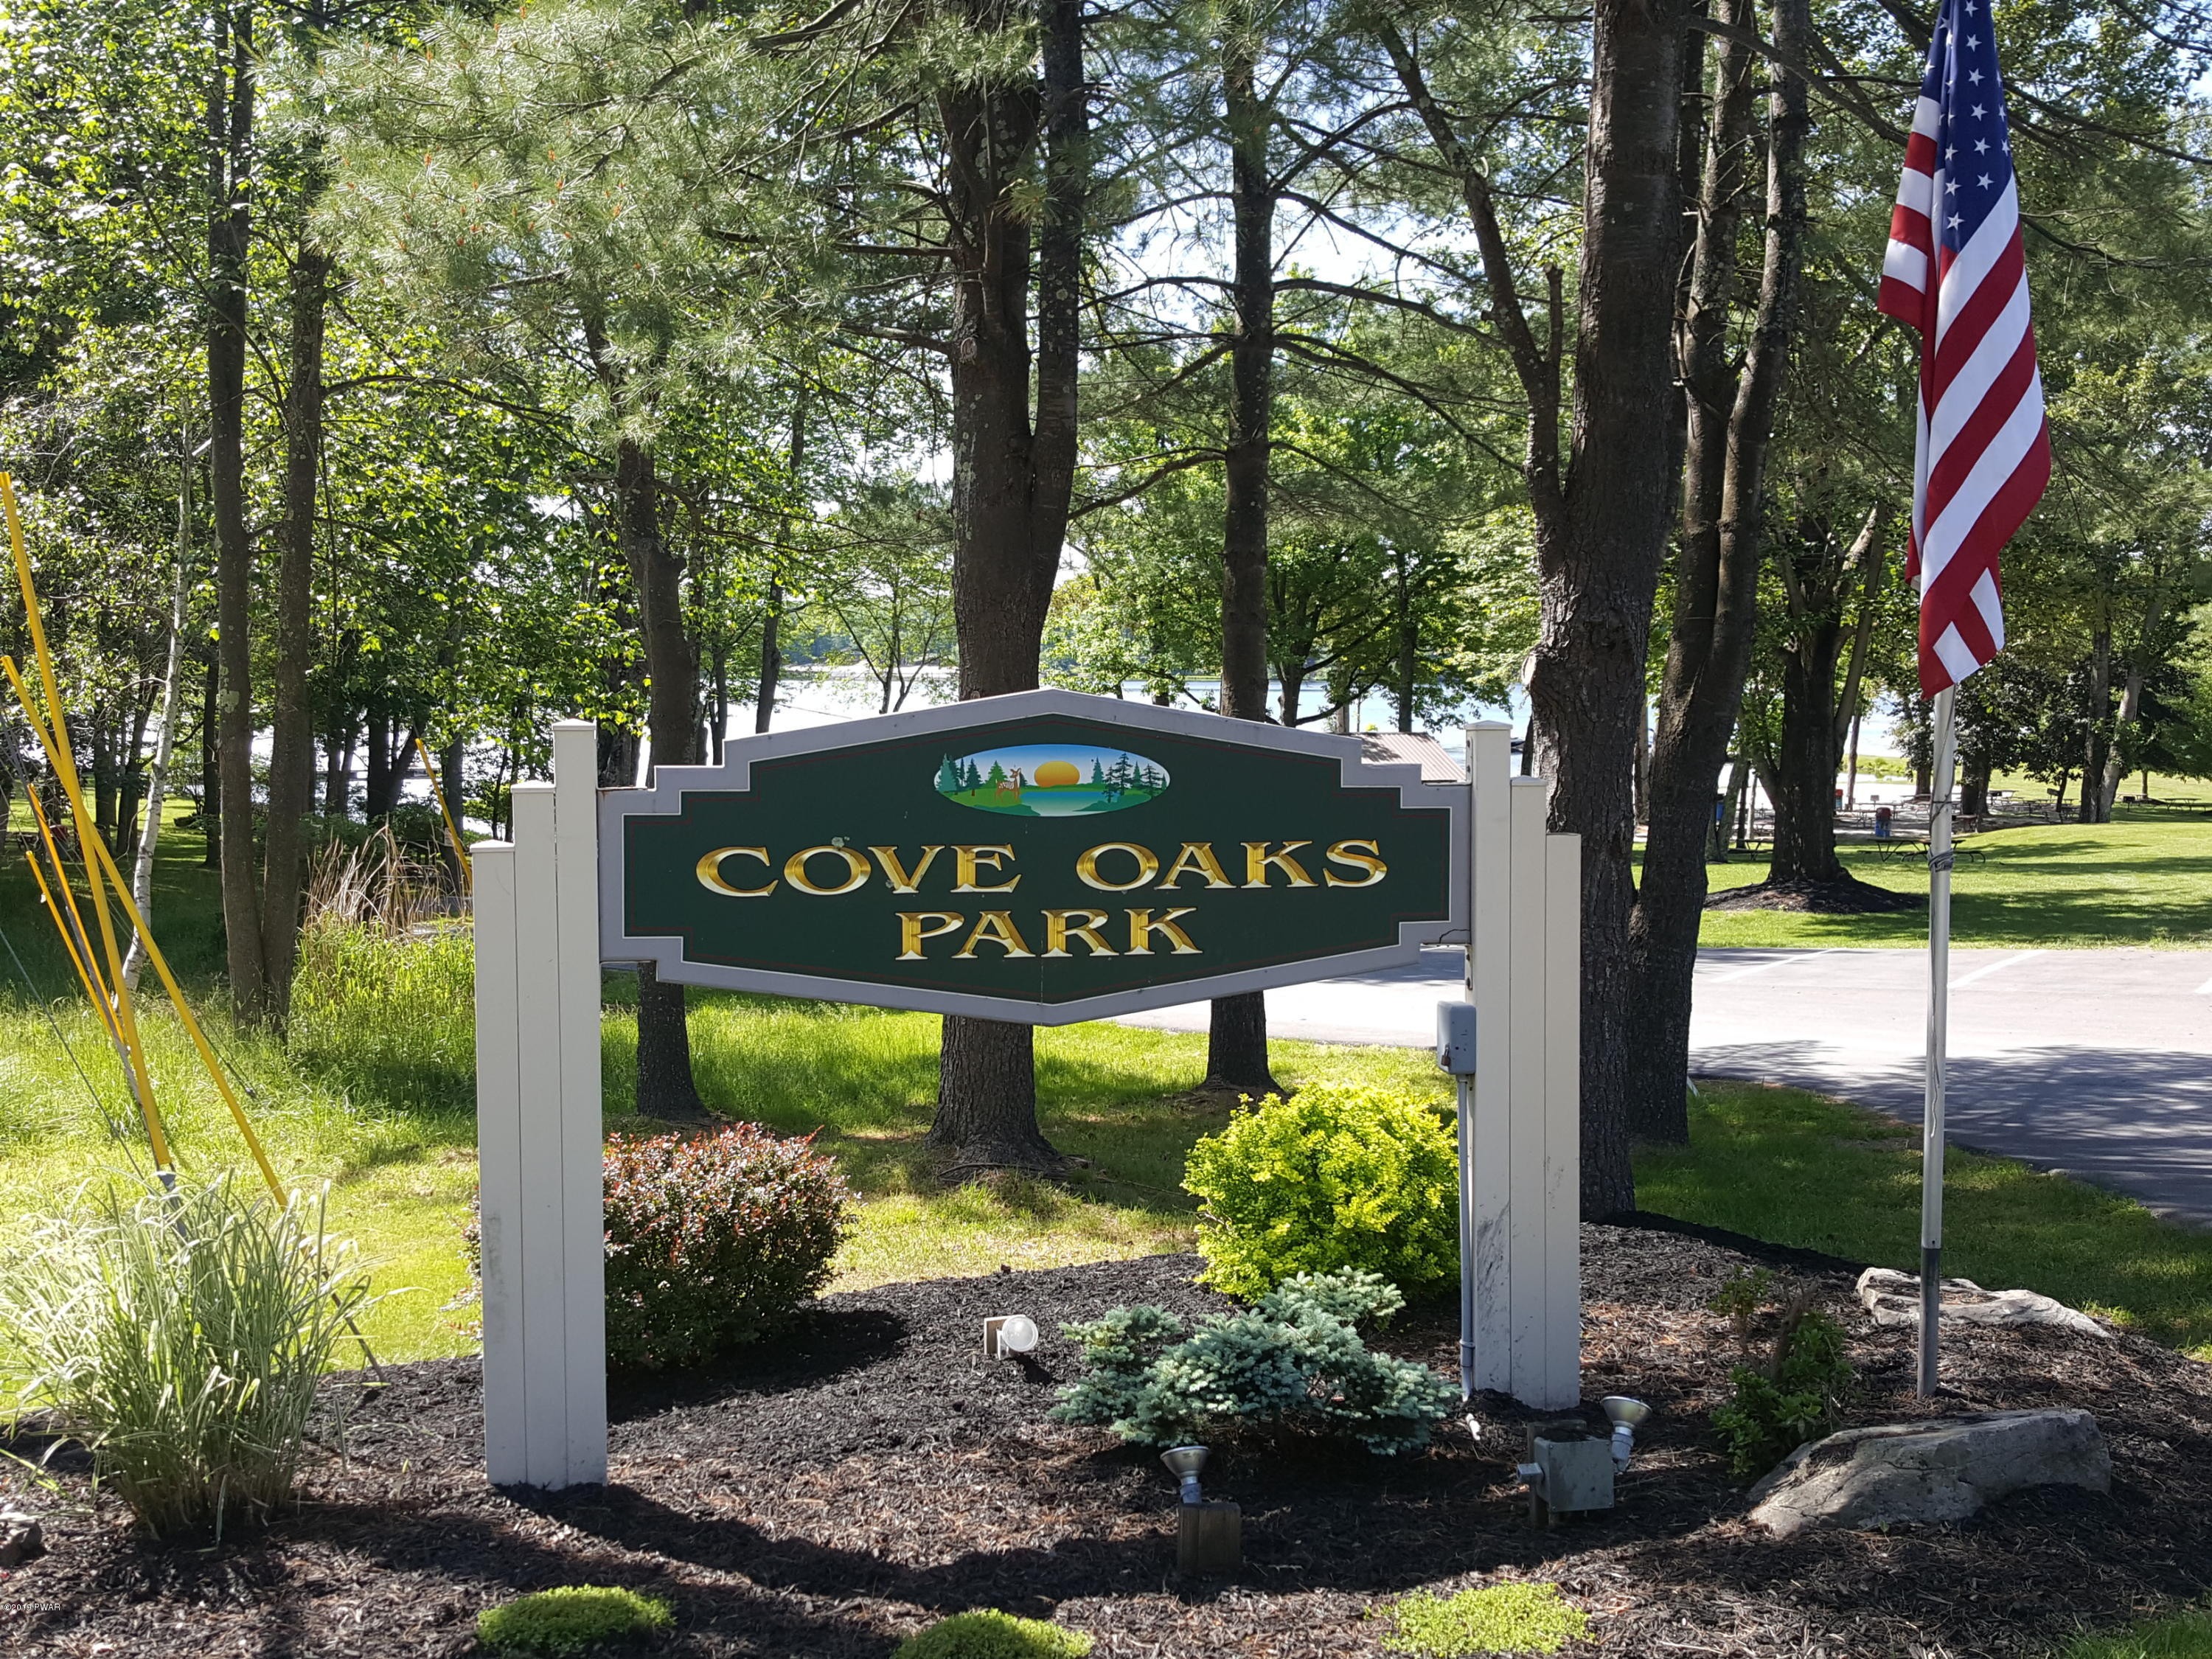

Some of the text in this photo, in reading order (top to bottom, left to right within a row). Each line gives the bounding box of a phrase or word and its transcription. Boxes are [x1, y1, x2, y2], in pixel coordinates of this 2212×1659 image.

[695, 839, 1389, 897] COVE OAKS
[894, 907, 1203, 960] PARK
